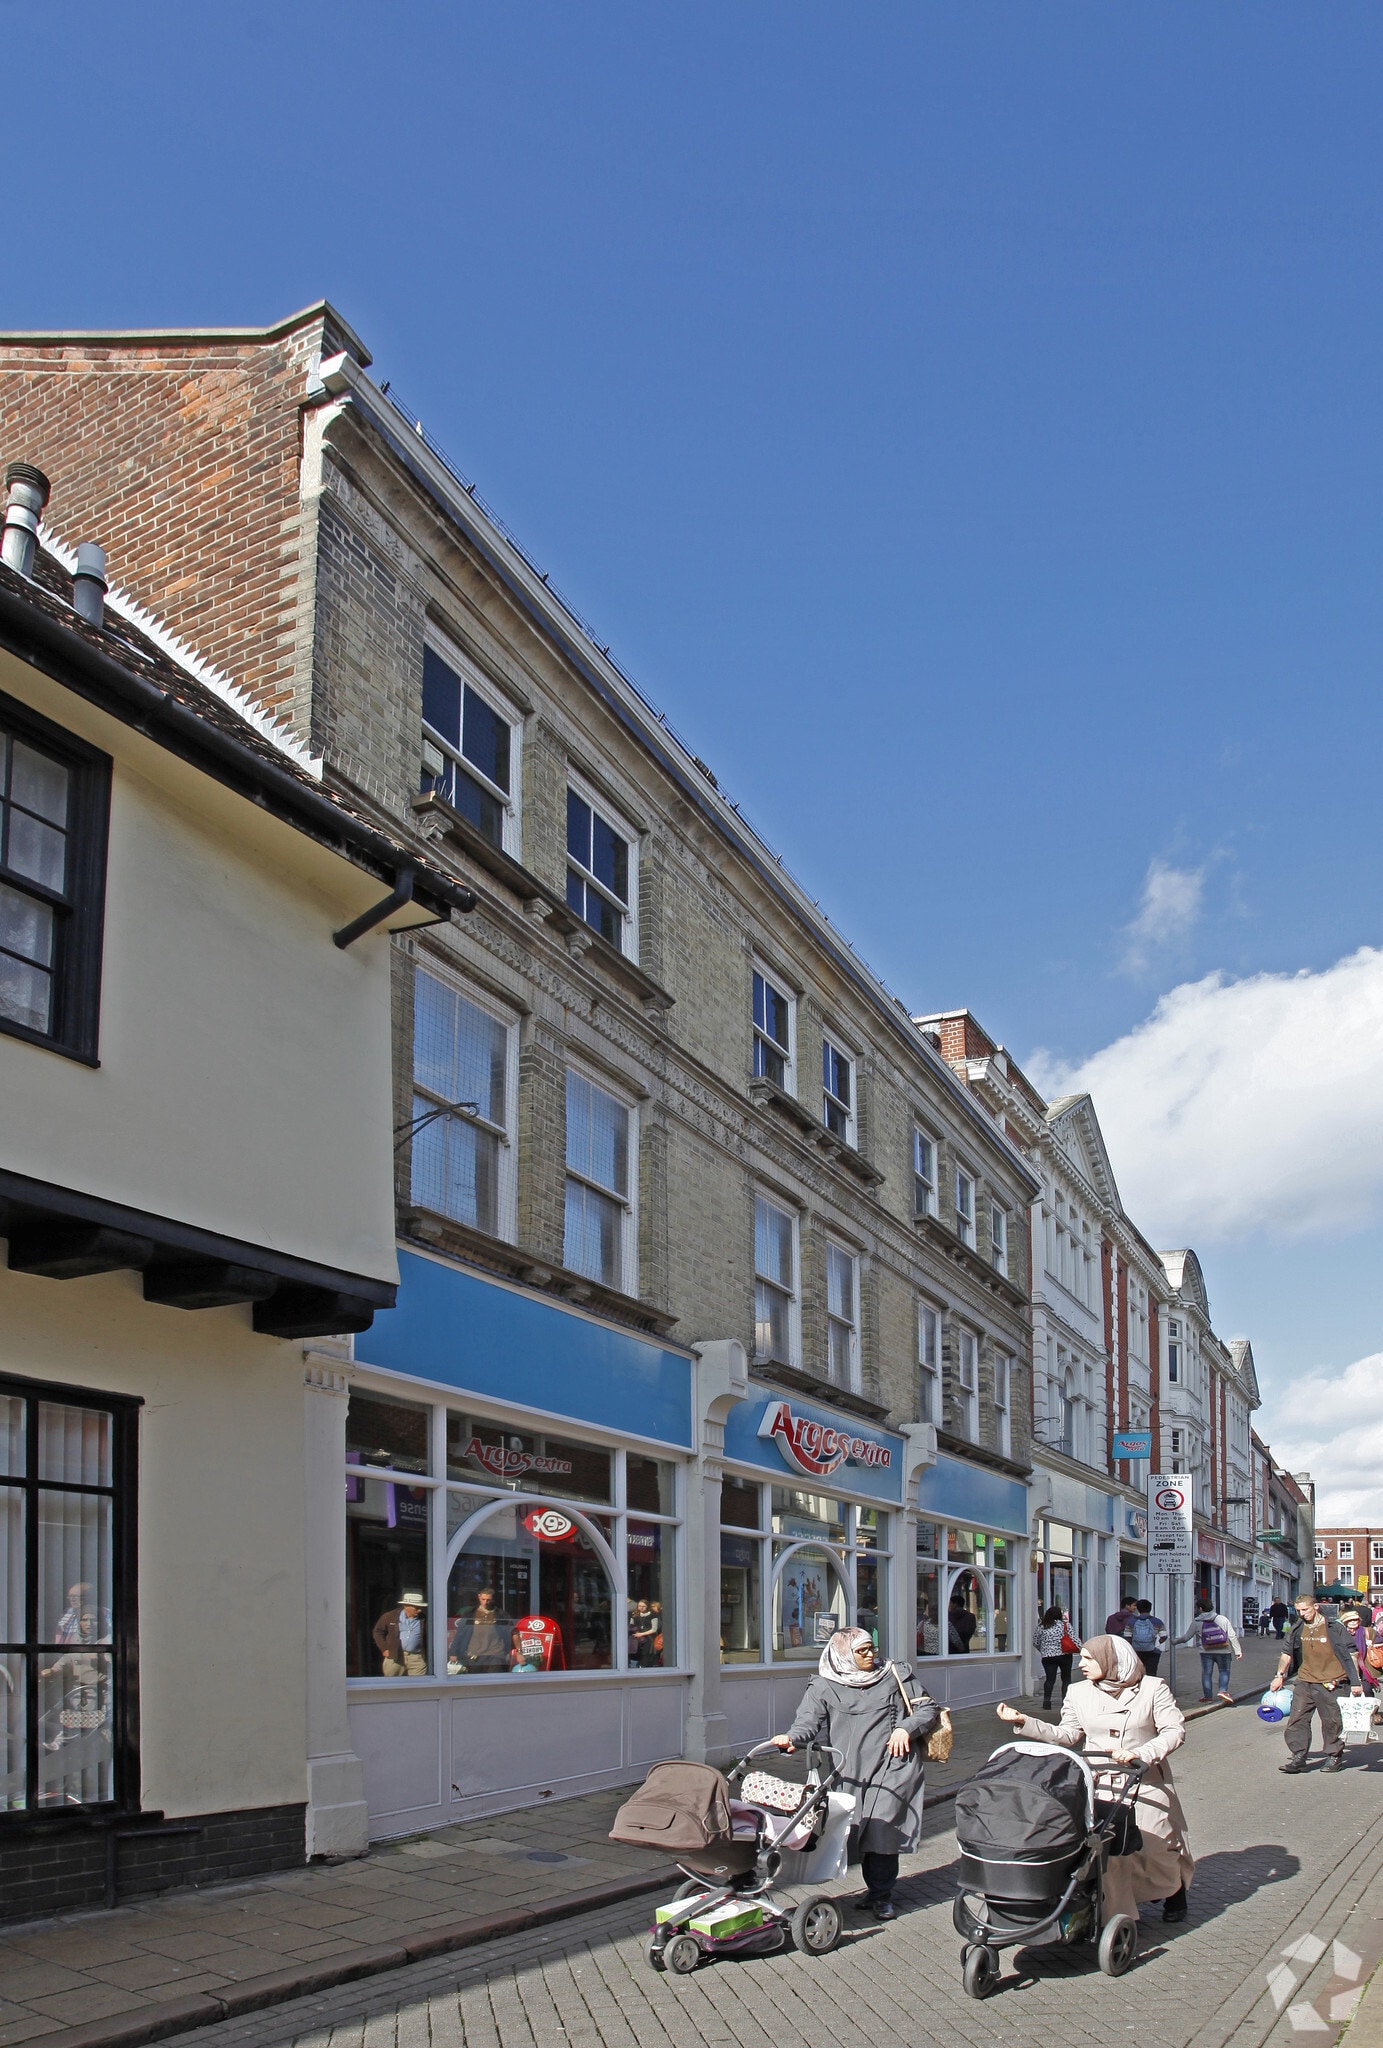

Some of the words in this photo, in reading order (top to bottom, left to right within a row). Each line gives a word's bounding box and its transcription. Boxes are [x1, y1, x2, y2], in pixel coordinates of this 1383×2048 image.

[463, 1437, 533, 1478] Argos
[534, 1456, 572, 1473] extra
[760, 1401, 851, 1476] Argos
[850, 1437, 892, 1468] extra
[1117, 1440, 1148, 1450] Argos
